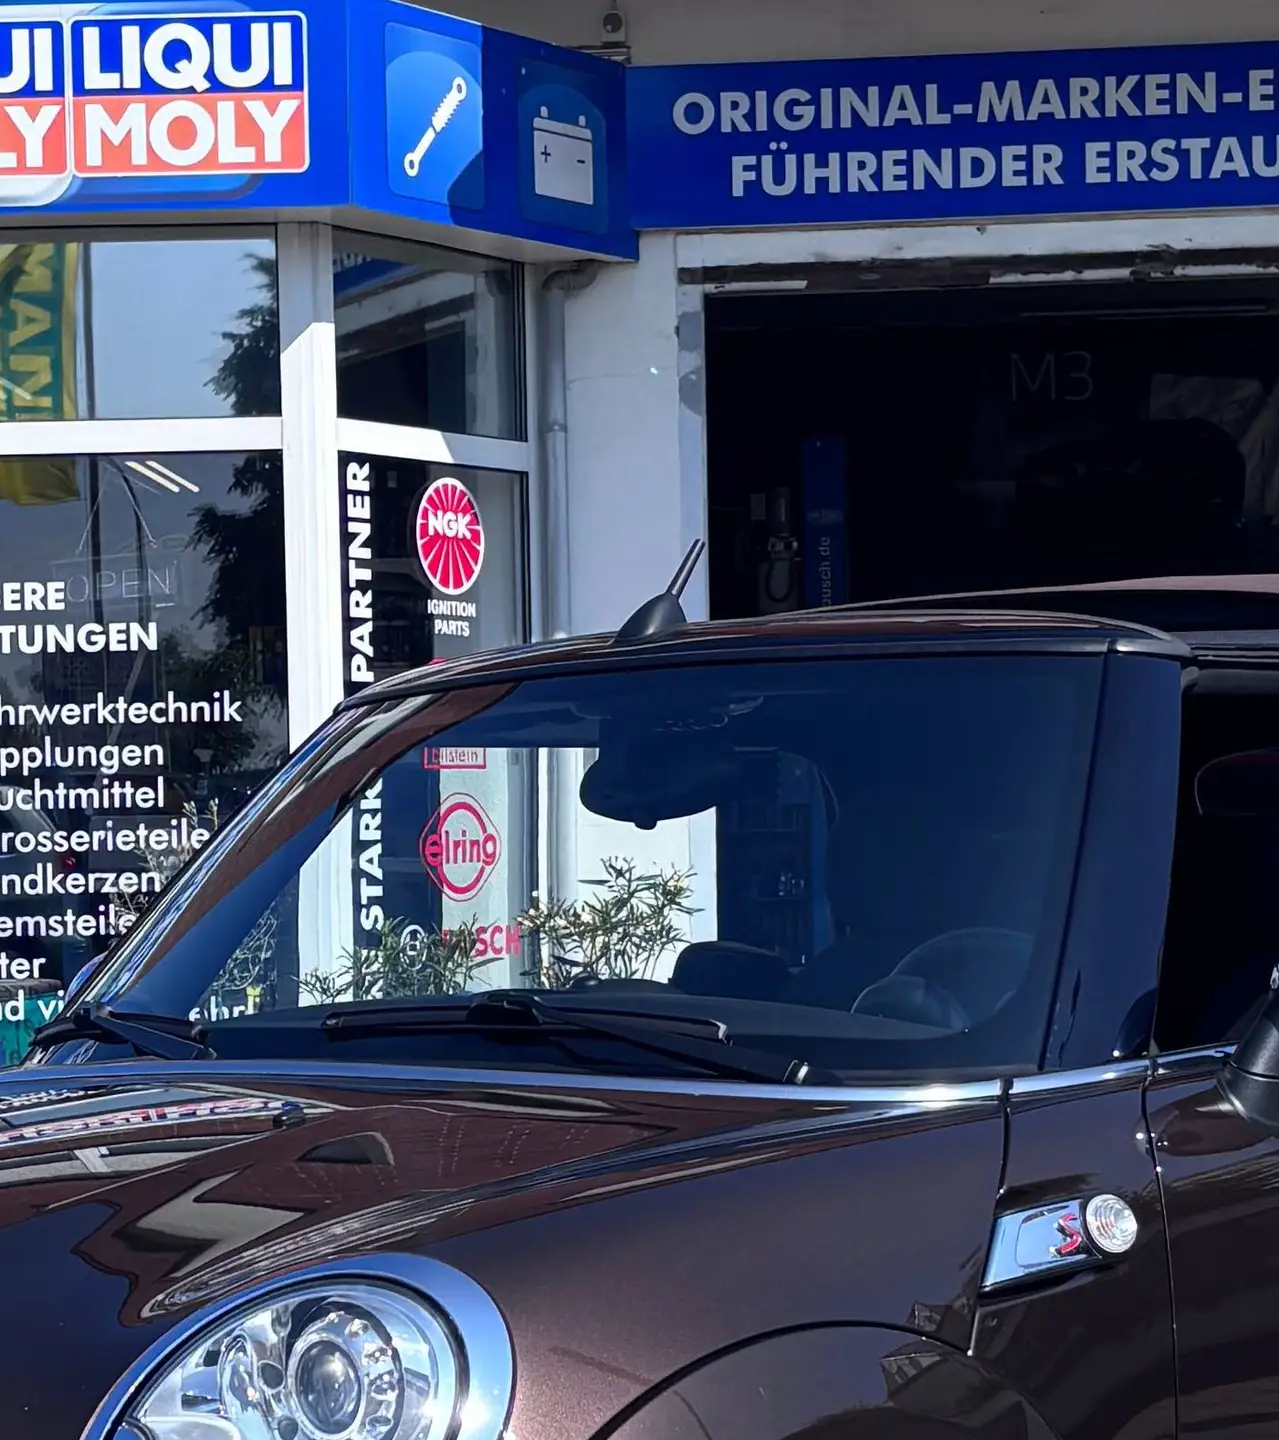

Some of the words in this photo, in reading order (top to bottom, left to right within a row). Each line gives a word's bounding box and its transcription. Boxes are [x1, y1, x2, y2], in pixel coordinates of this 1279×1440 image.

[83, 20, 293, 96] LIQUI
[86, 100, 302, 169] MOLY
[732, 142, 1063, 197] FÜHRENDER
[1010, 352, 1094, 402] M3
[427, 509, 472, 540] NGK
[66, 567, 170, 602] OPEN
[346, 461, 374, 684] PARTNER
[428, 599, 476, 620] IGNITION
[435, 619, 471, 637] PARTS
[425, 829, 497, 867] elring
